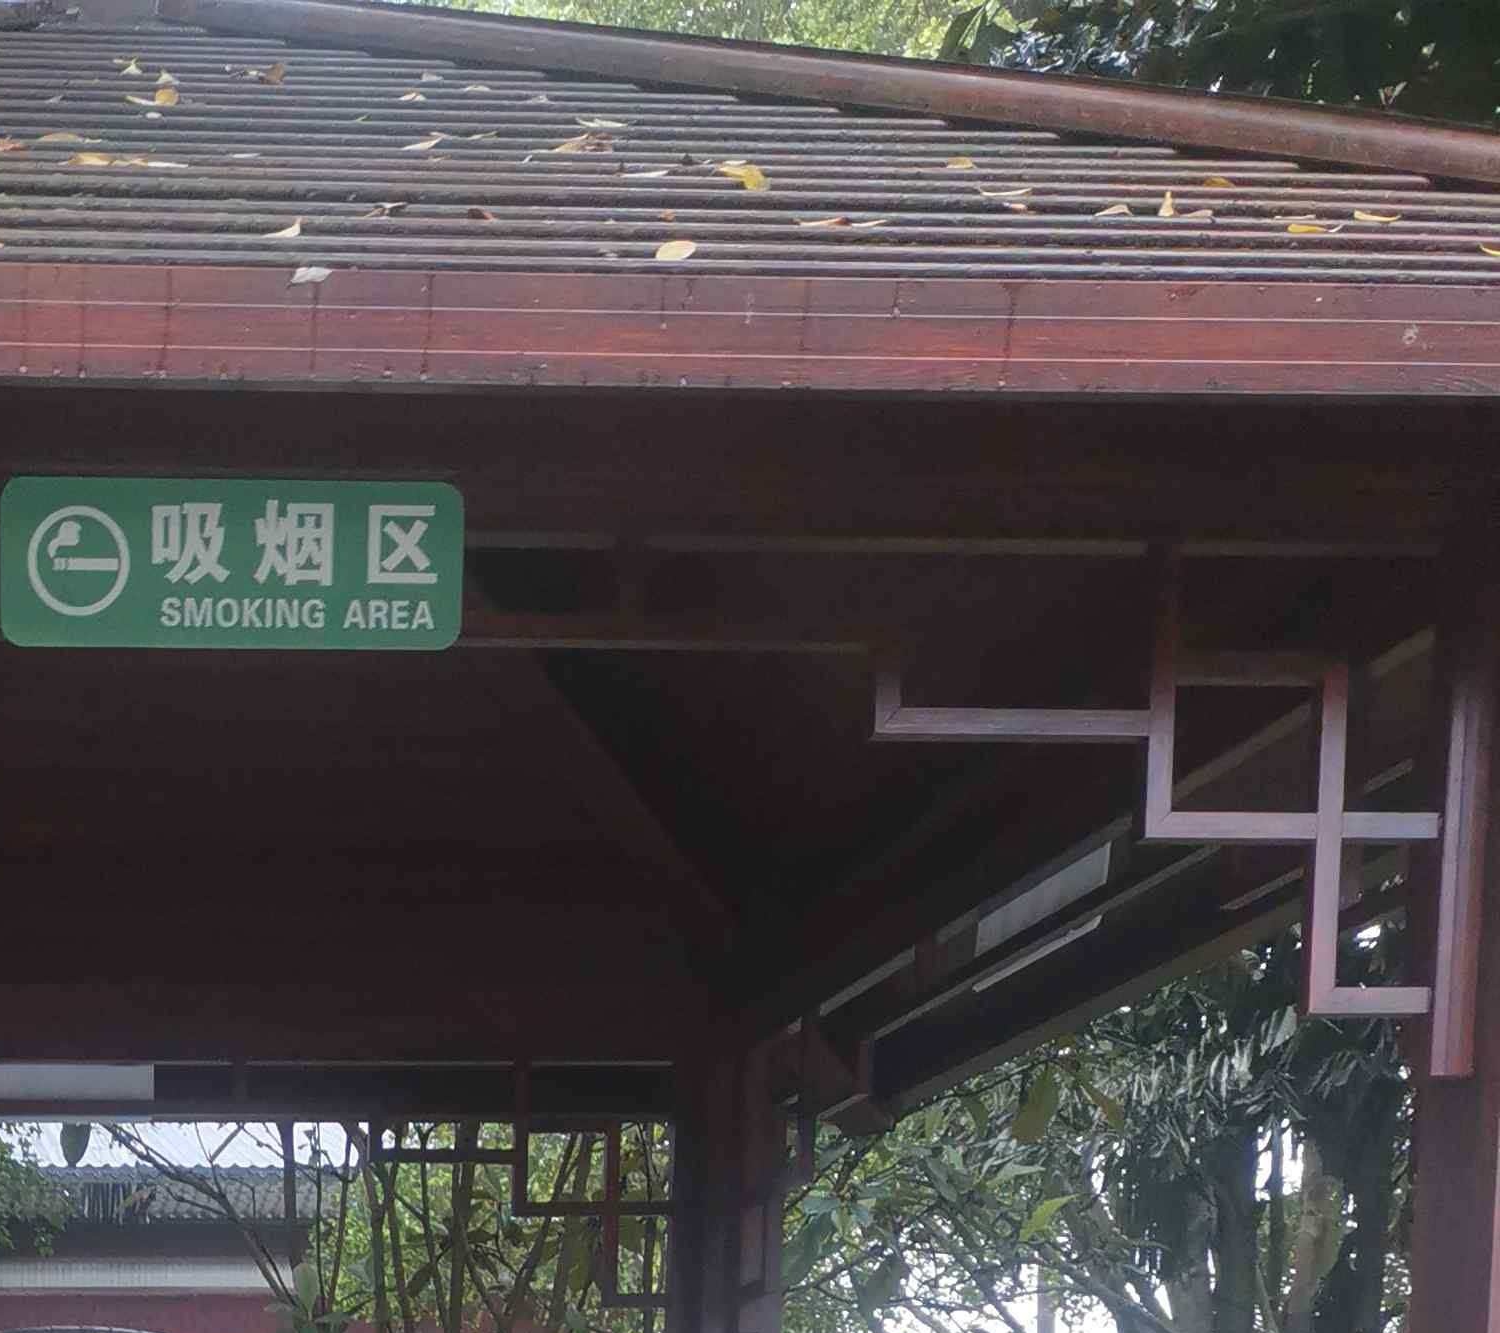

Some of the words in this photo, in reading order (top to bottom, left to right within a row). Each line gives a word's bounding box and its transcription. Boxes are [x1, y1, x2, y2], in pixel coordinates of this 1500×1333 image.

[151, 499, 438, 587] 吸烟区
[160, 596, 326, 630] SMOKING
[342, 599, 437, 631] AREA
